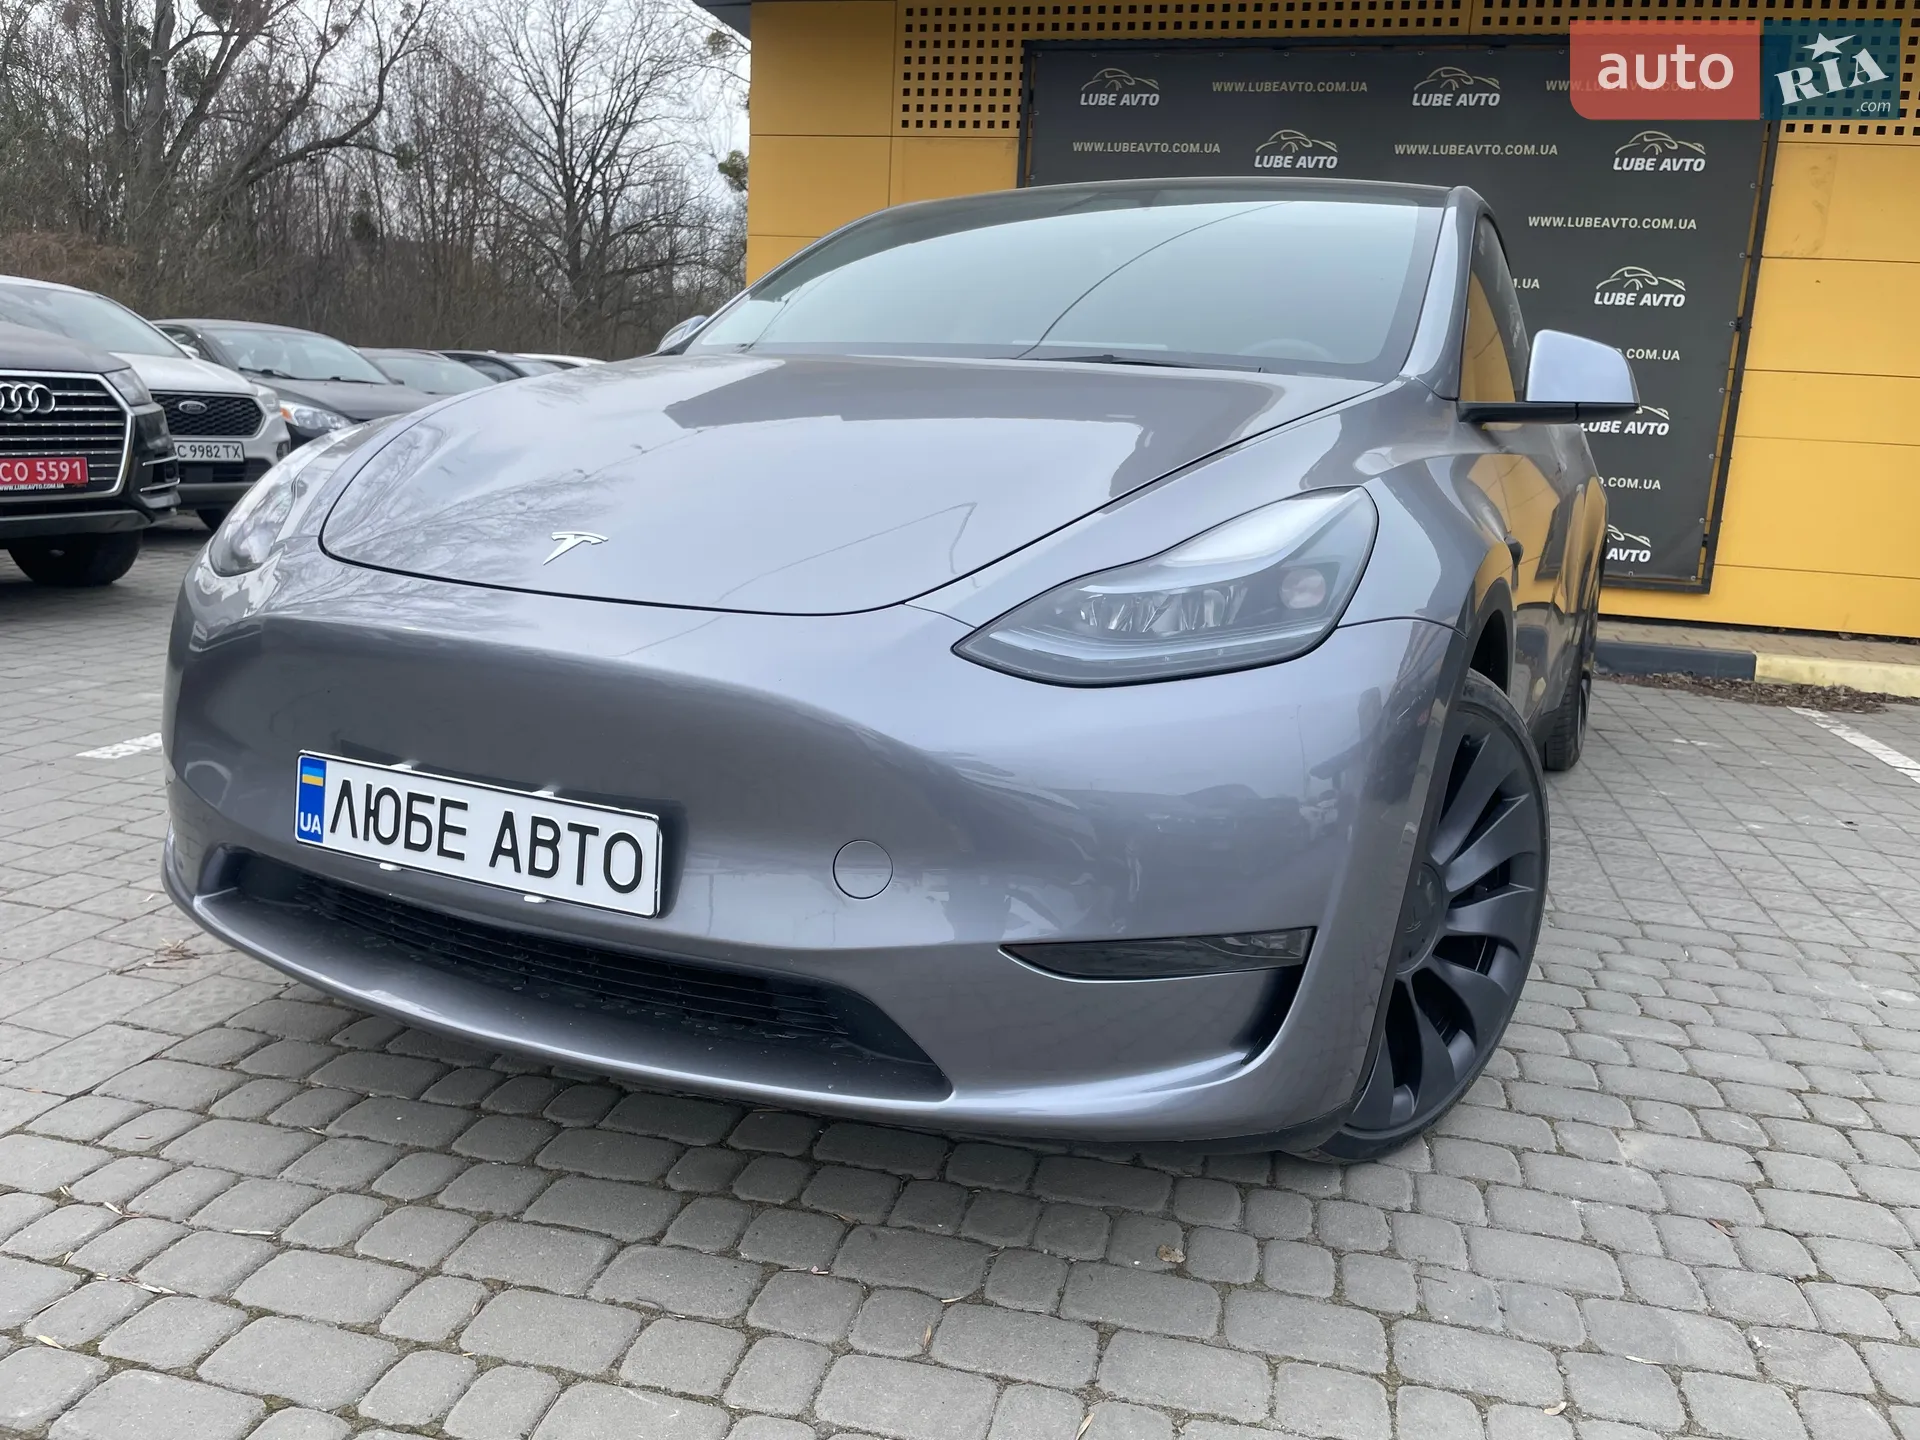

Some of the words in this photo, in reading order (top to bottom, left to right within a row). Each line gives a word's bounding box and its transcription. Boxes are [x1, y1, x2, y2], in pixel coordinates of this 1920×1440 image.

[1211, 80, 1368, 93] WWW.LUBEAVTO.COM.UA
[1080, 93, 1117, 106] LUBE
[1119, 93, 1160, 107] AVTO
[1412, 93, 1453, 107] LUBE
[1455, 93, 1501, 107] AVTO
[1072, 141, 1221, 154] WWW.LUBEAVTO.COM.UA
[1394, 144, 1558, 156] WWW.LUBEAVTO.COM.UA
[1254, 155, 1294, 169] LUBE
[1295, 155, 1338, 169] AVTO
[1612, 157, 1657, 171] LUBE
[1658, 157, 1706, 172] AVTO
[1527, 216, 1698, 230] WWW.LUBEAVTO.COM.UA
[1593, 291, 1637, 306] LUBE
[1639, 292, 1686, 308] AVTO
[1615, 347, 1681, 361] COM.UA
[1580, 420, 1622, 434] LUBE
[1623, 421, 1670, 436] AVTO
[177, 444, 187, 458] C
[189, 444, 221, 459] 9982
[222, 445, 241, 459] TX
[36, 461, 82, 481] 5591
[1606, 547, 1652, 563] AVTO
[299, 812, 322, 836] UA
[329, 779, 470, 862] ЛЮБЕ
[488, 810, 644, 894] АВТО
